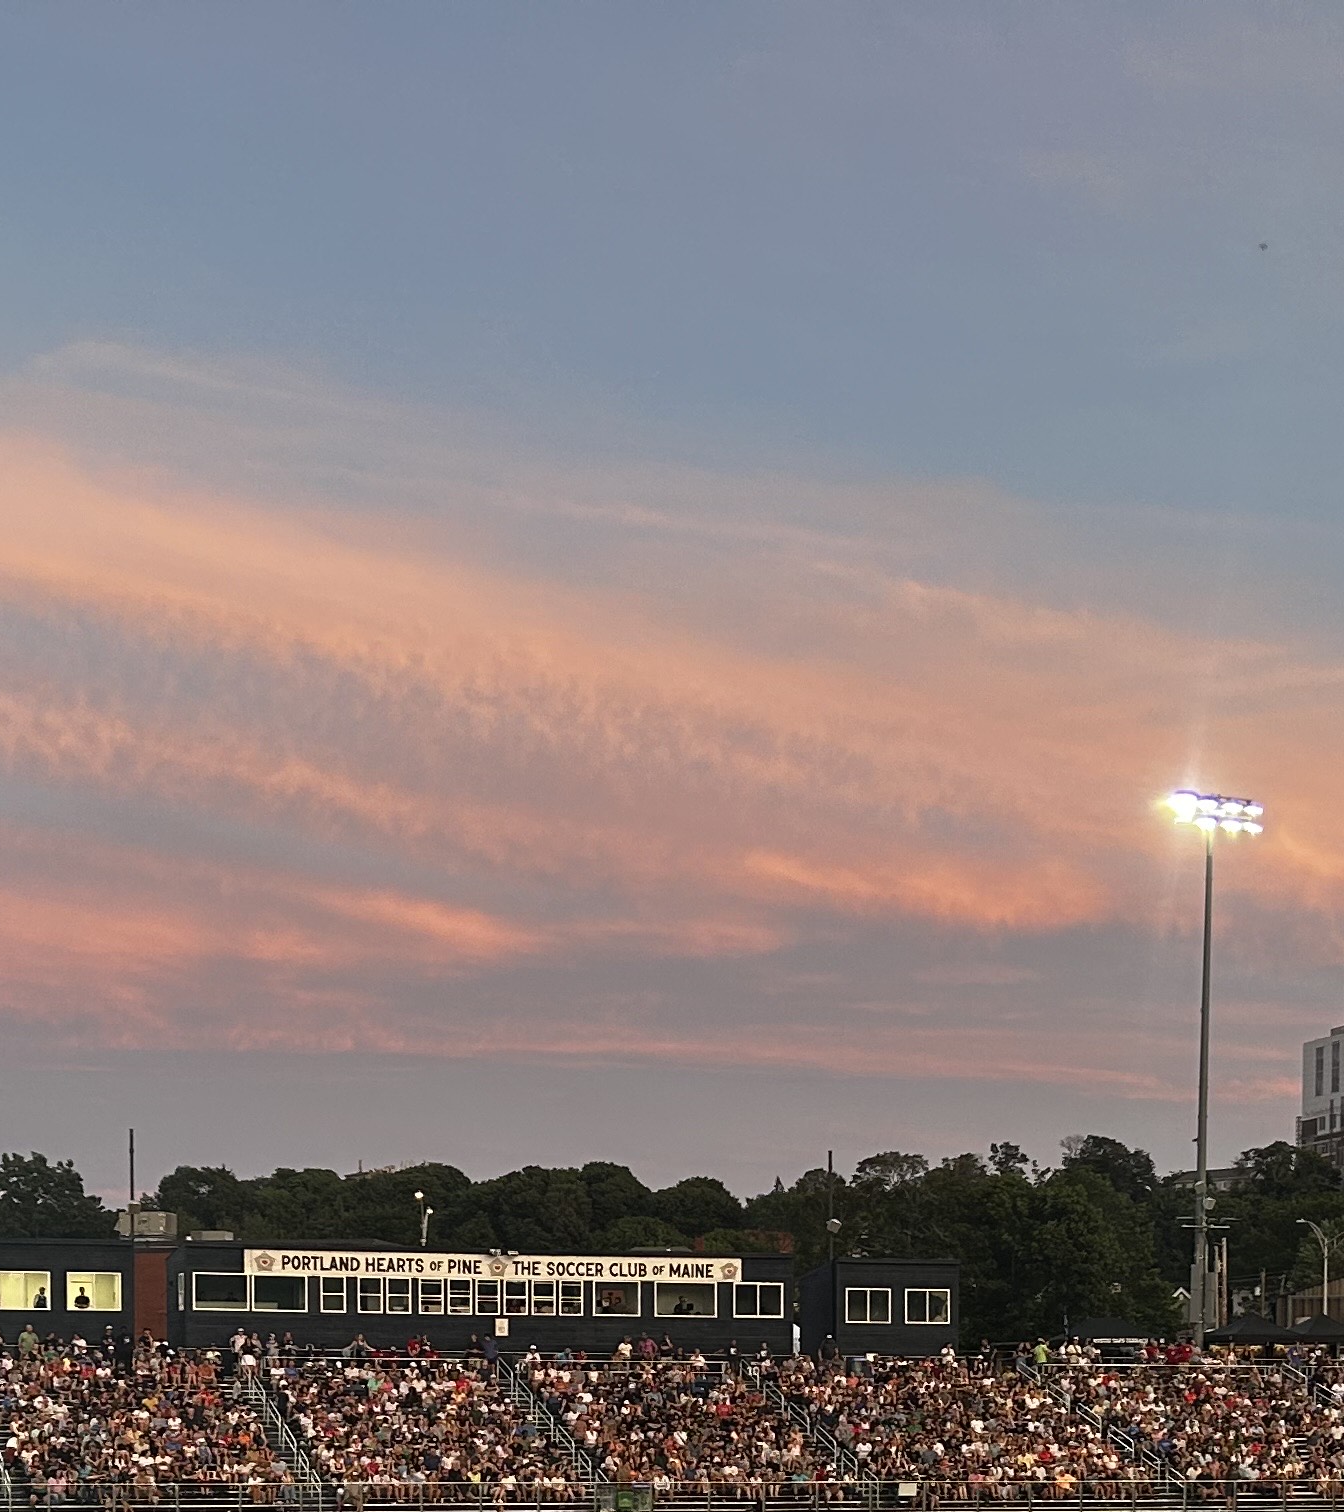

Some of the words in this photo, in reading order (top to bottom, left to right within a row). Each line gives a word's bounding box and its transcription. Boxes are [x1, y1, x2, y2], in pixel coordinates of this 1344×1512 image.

[281, 1254, 361, 1272] PORTLAND
[365, 1257, 425, 1274] HEARTS
[447, 1259, 483, 1275] PINE
[512, 1261, 540, 1275] THE
[546, 1261, 605, 1277] SOCCER
[609, 1262, 648, 1278] CLUB
[669, 1263, 715, 1279] MAINE
